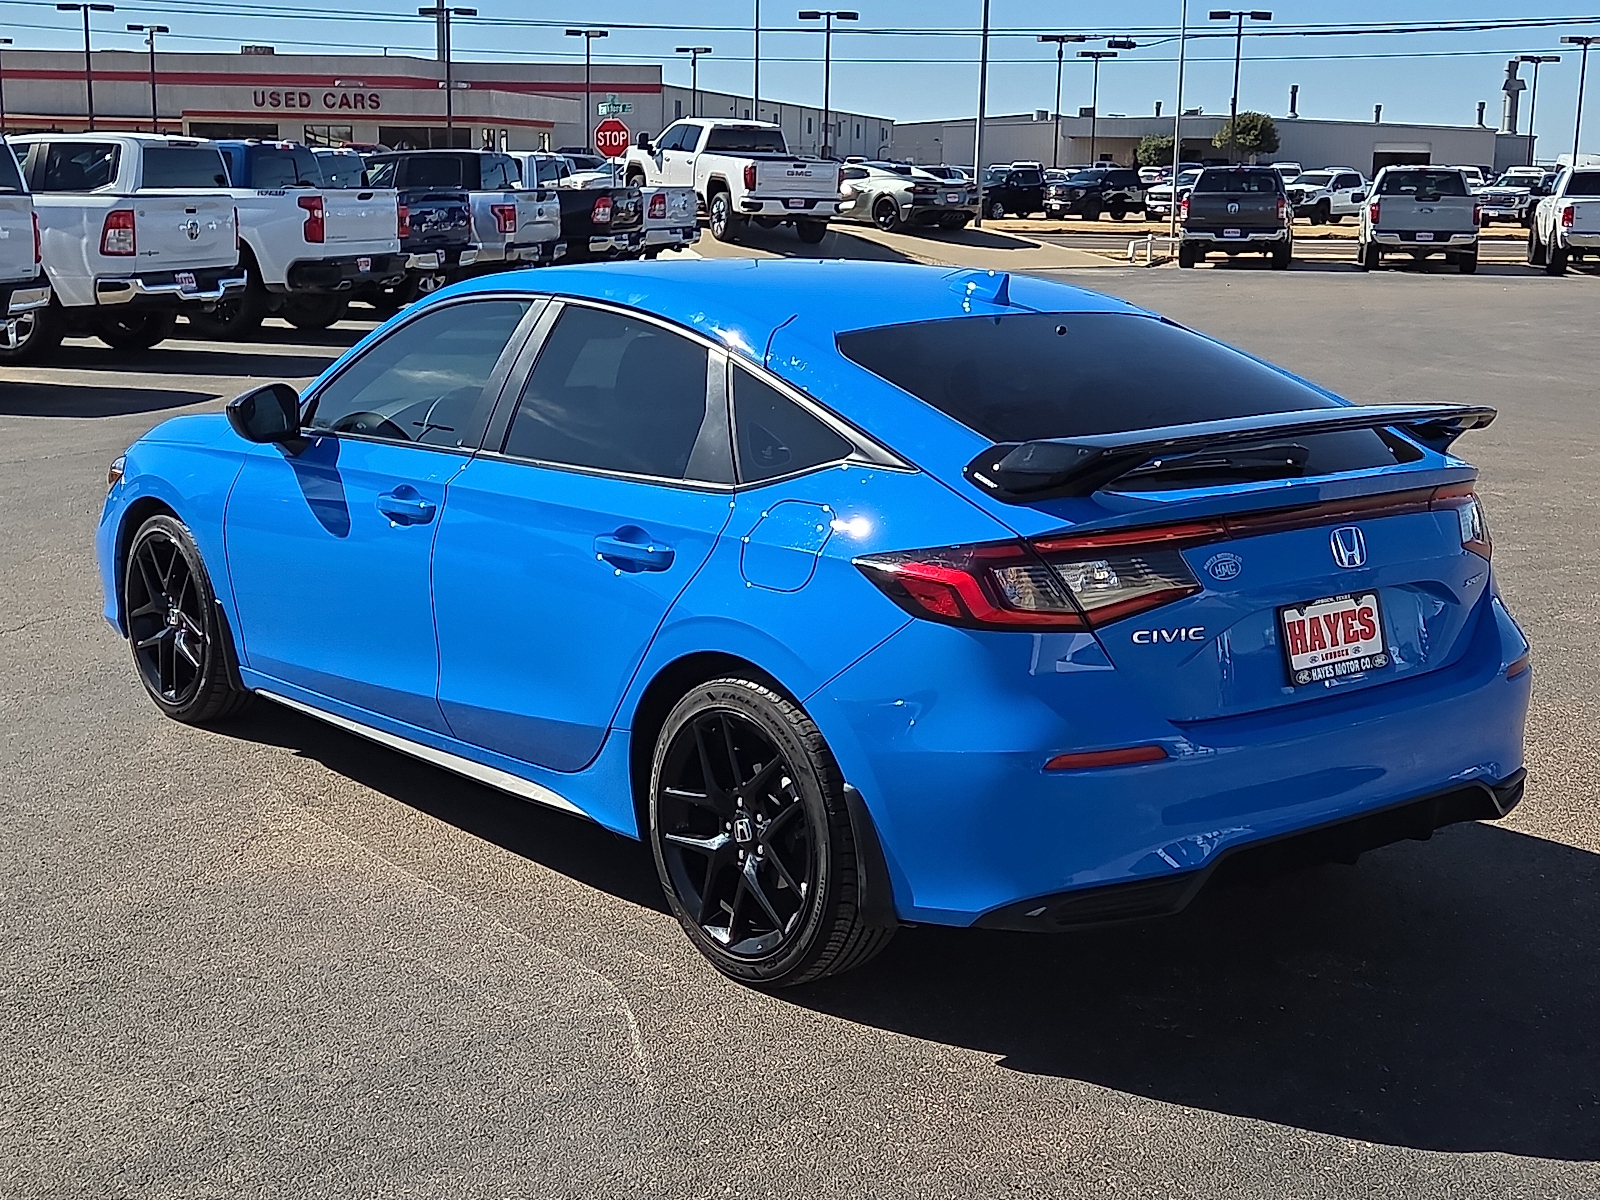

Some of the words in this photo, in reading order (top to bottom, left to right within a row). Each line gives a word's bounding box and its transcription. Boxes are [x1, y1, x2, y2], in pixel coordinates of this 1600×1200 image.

[253, 90, 312, 108] USED
[323, 92, 381, 110] CARS
[597, 131, 628, 147] STOP
[1132, 626, 1206, 644] CIVIC
[1286, 606, 1377, 656] HAYES
[1311, 665, 1335, 681] HAYES
[1335, 660, 1360, 676] MOTOR
[1360, 657, 1374, 670] CO.
